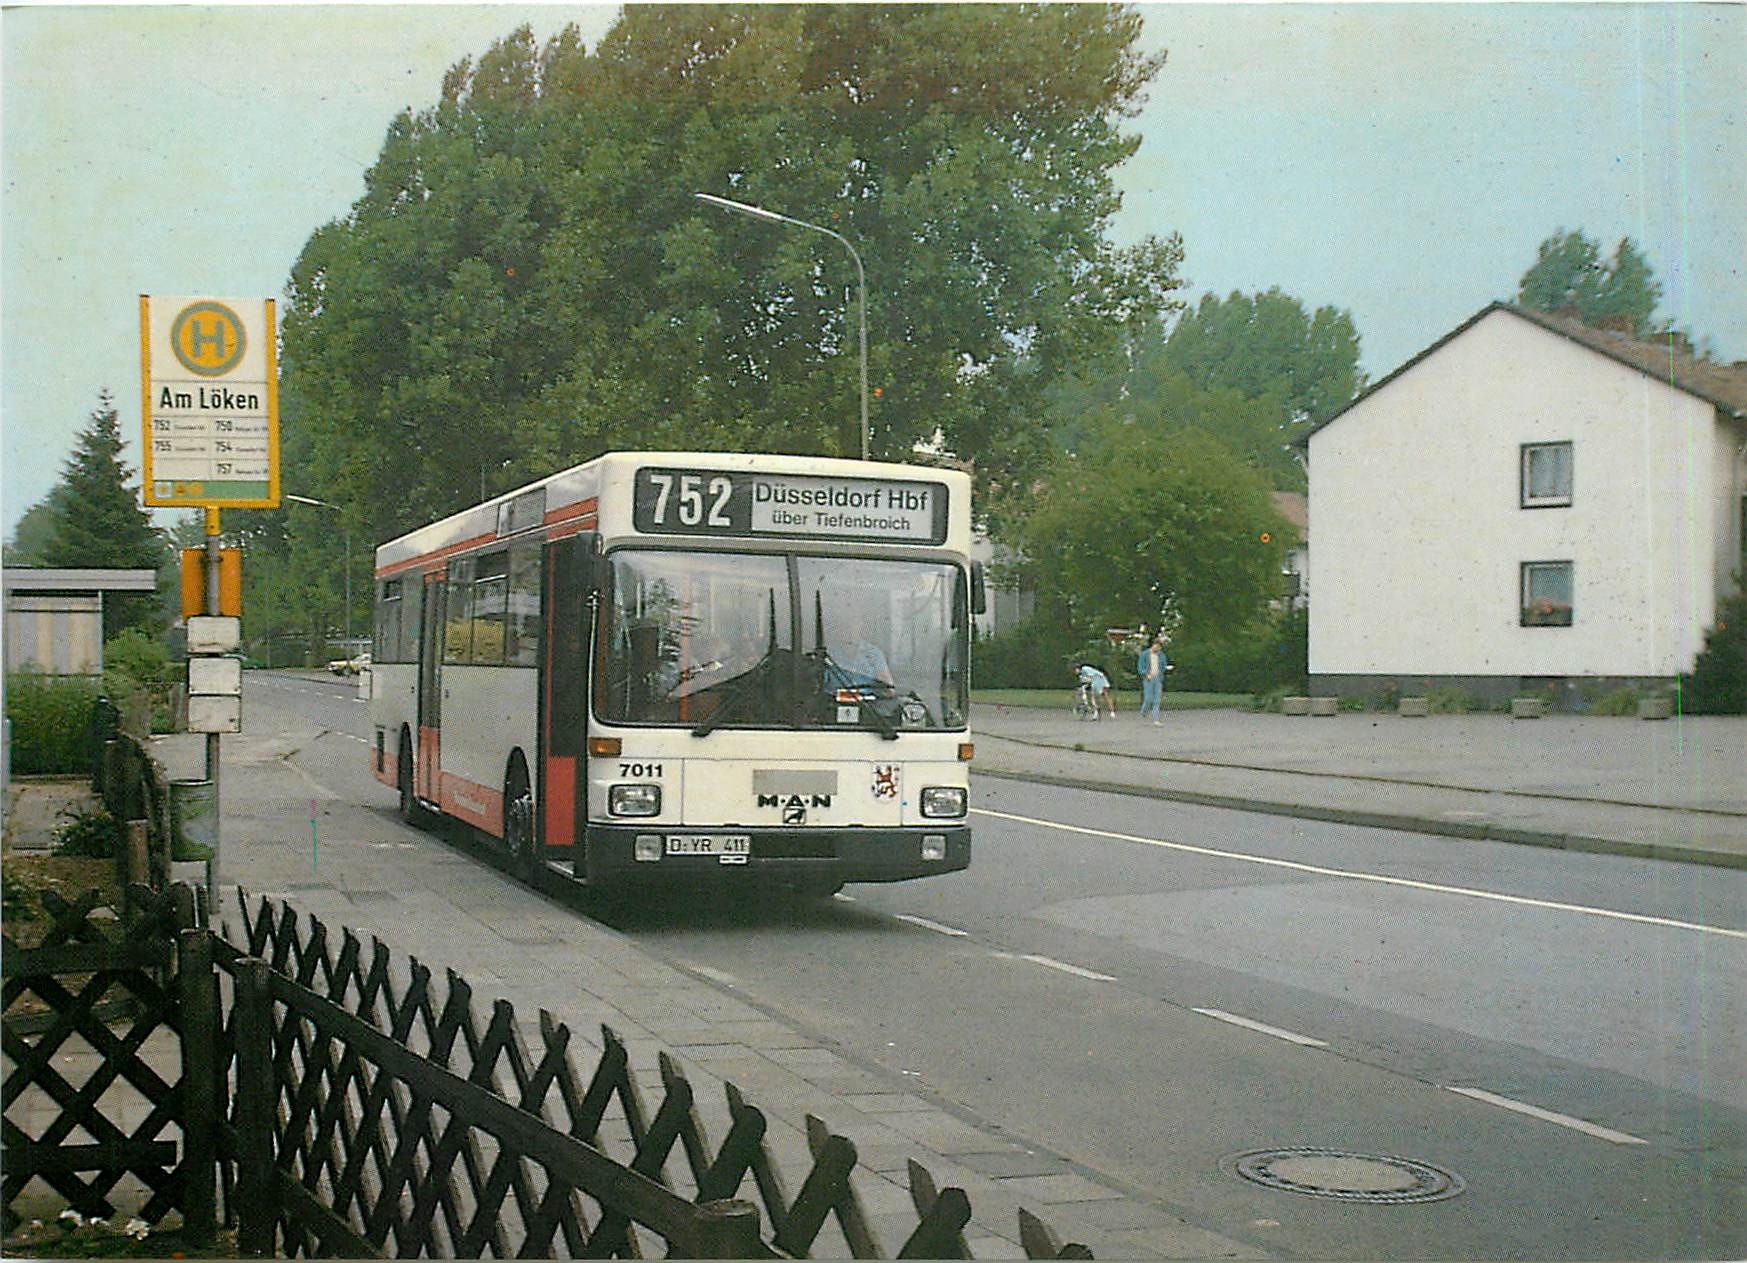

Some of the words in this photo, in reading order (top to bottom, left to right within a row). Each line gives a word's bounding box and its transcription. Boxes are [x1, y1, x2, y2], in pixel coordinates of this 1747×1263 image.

[191, 319, 224, 358] H
[160, 386, 192, 409] Am
[200, 387, 259, 410] Löken
[154, 419, 171, 431] 752
[650, 473, 732, 528] 752
[755, 482, 881, 510] Düsseldorf
[888, 488, 930, 511] Hbf
[772, 510, 809, 527] über
[815, 511, 911, 531] Tiefenbroich
[619, 763, 664, 778] 7011
